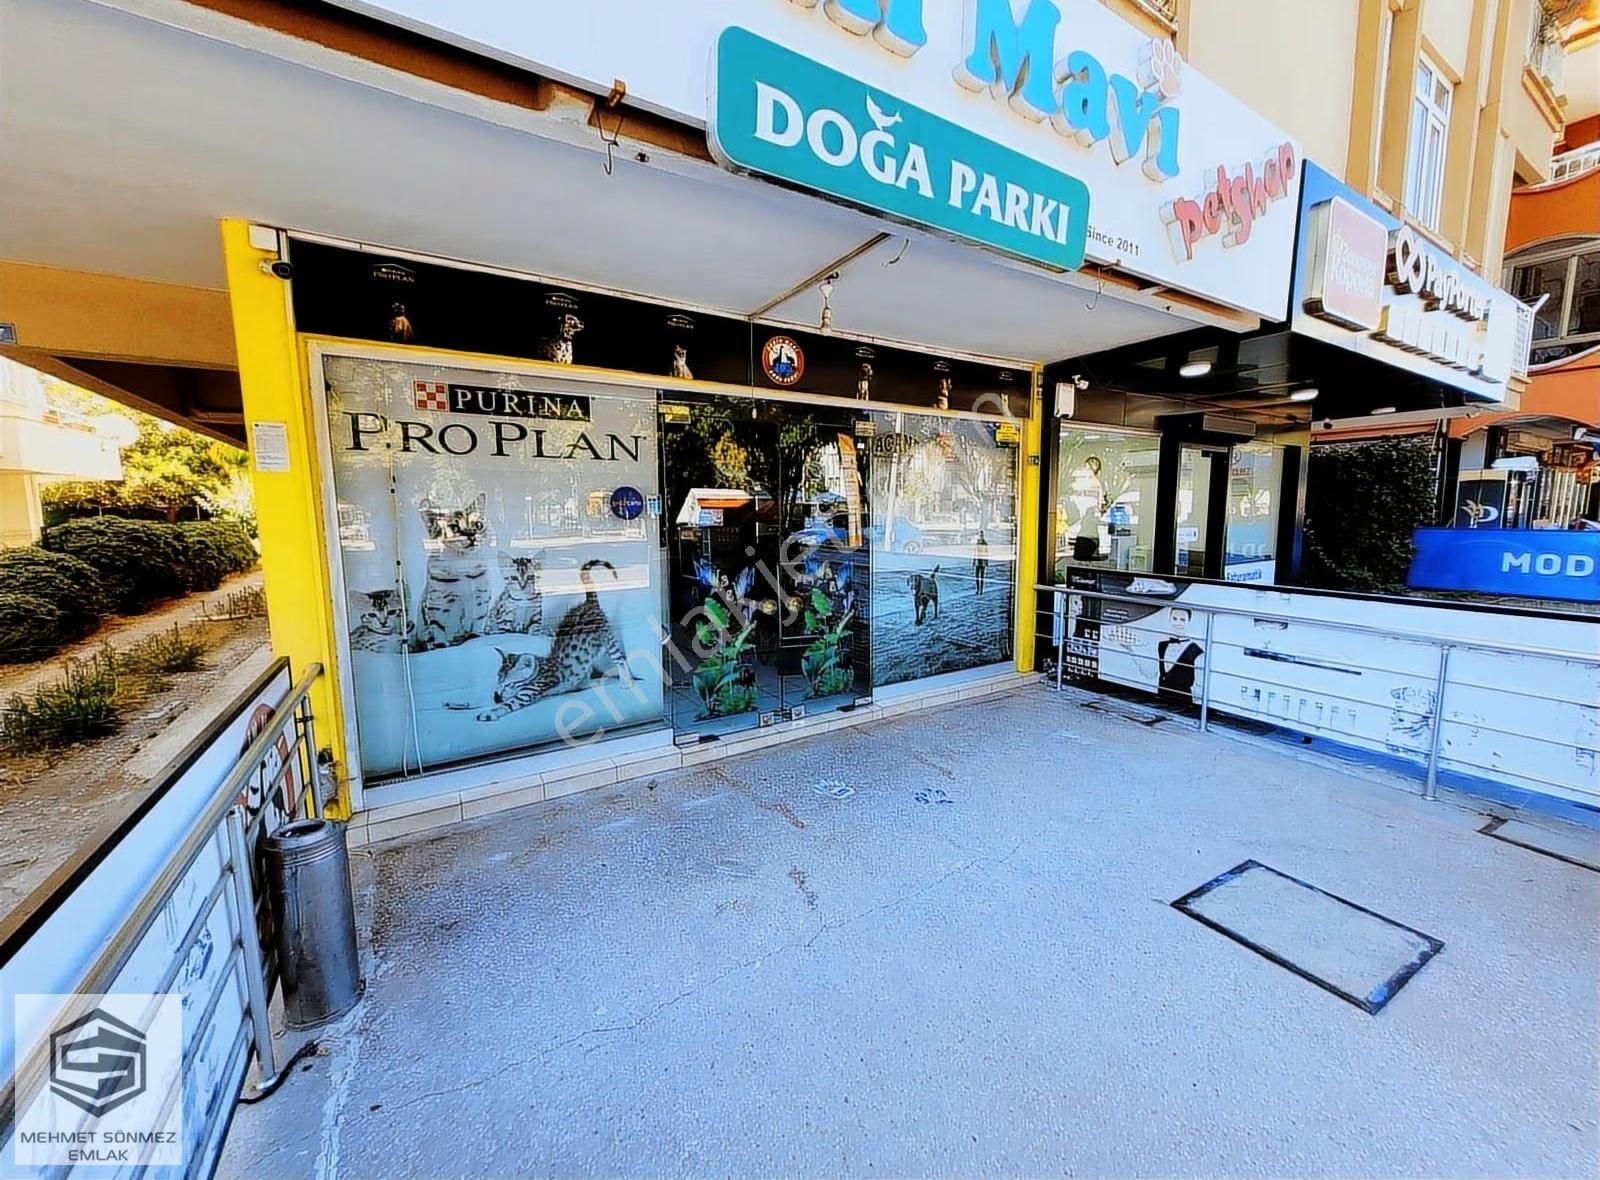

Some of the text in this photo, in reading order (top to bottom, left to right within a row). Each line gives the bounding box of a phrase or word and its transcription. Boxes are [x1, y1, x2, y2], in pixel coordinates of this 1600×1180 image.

[962, 0, 1180, 178] Mavi
[754, 80, 1072, 246] DOĞA PARKI
[1087, 225, 1140, 256] Since 2011
[455, 388, 584, 418] PURINA
[343, 411, 642, 463] PRO PLAN
[1502, 552, 1595, 577] MOD
